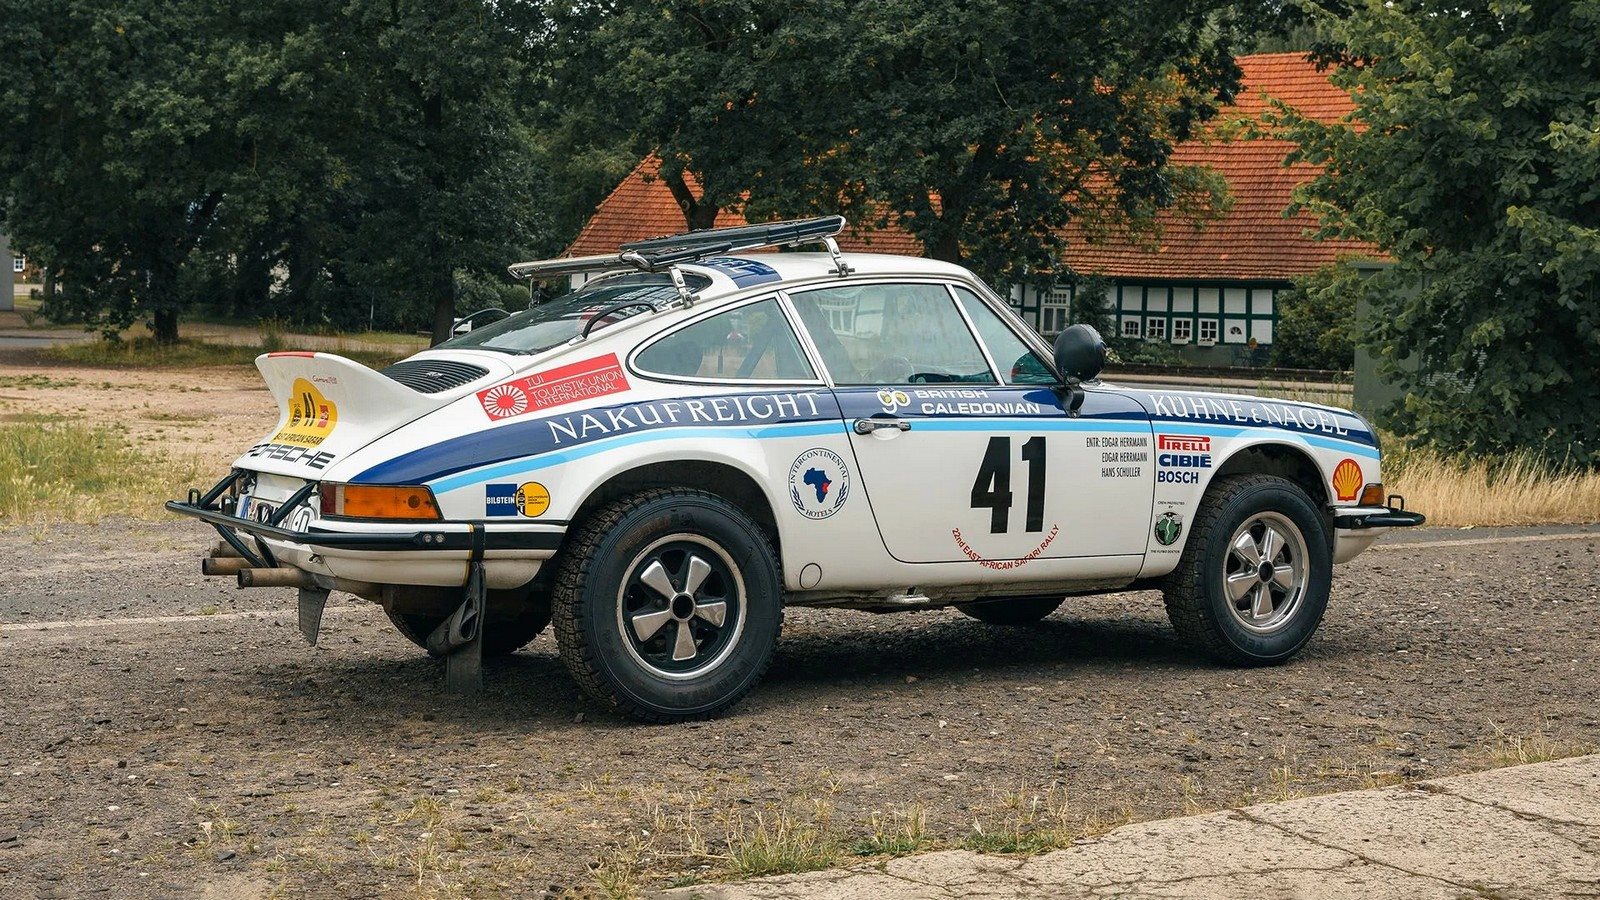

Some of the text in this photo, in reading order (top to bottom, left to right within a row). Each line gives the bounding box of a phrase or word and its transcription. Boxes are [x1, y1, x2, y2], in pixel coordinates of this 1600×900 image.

[524, 375, 544, 387] TUI
[531, 370, 624, 399] TOURISTIK UNION
[535, 383, 618, 407] INTERNATIONAL
[914, 390, 988, 399] BRITISH
[921, 403, 1041, 415] CALEDONIAN
[1149, 394, 1249, 422] KÜHNE
[1260, 403, 1349, 436] NAGEL
[546, 392, 820, 444] NAKUFREIGHT
[1086, 437, 1148, 448] ENTR: EDGAR HERRMANN
[1158, 434, 1211, 452] PIRELLI
[1102, 452, 1148, 463] EDGAR HERRMANN
[790, 450, 848, 484] INTERCONTINENTAL
[1101, 467, 1116, 478] HANS
[1157, 470, 1199, 484] BOSCH
[971, 436, 1046, 533] 41
[486, 496, 515, 505] BILSTEIN
[805, 508, 833, 518] HOTELS
[951, 524, 1060, 570] 22nd EAST AFRICAN SAFARI RALLY
